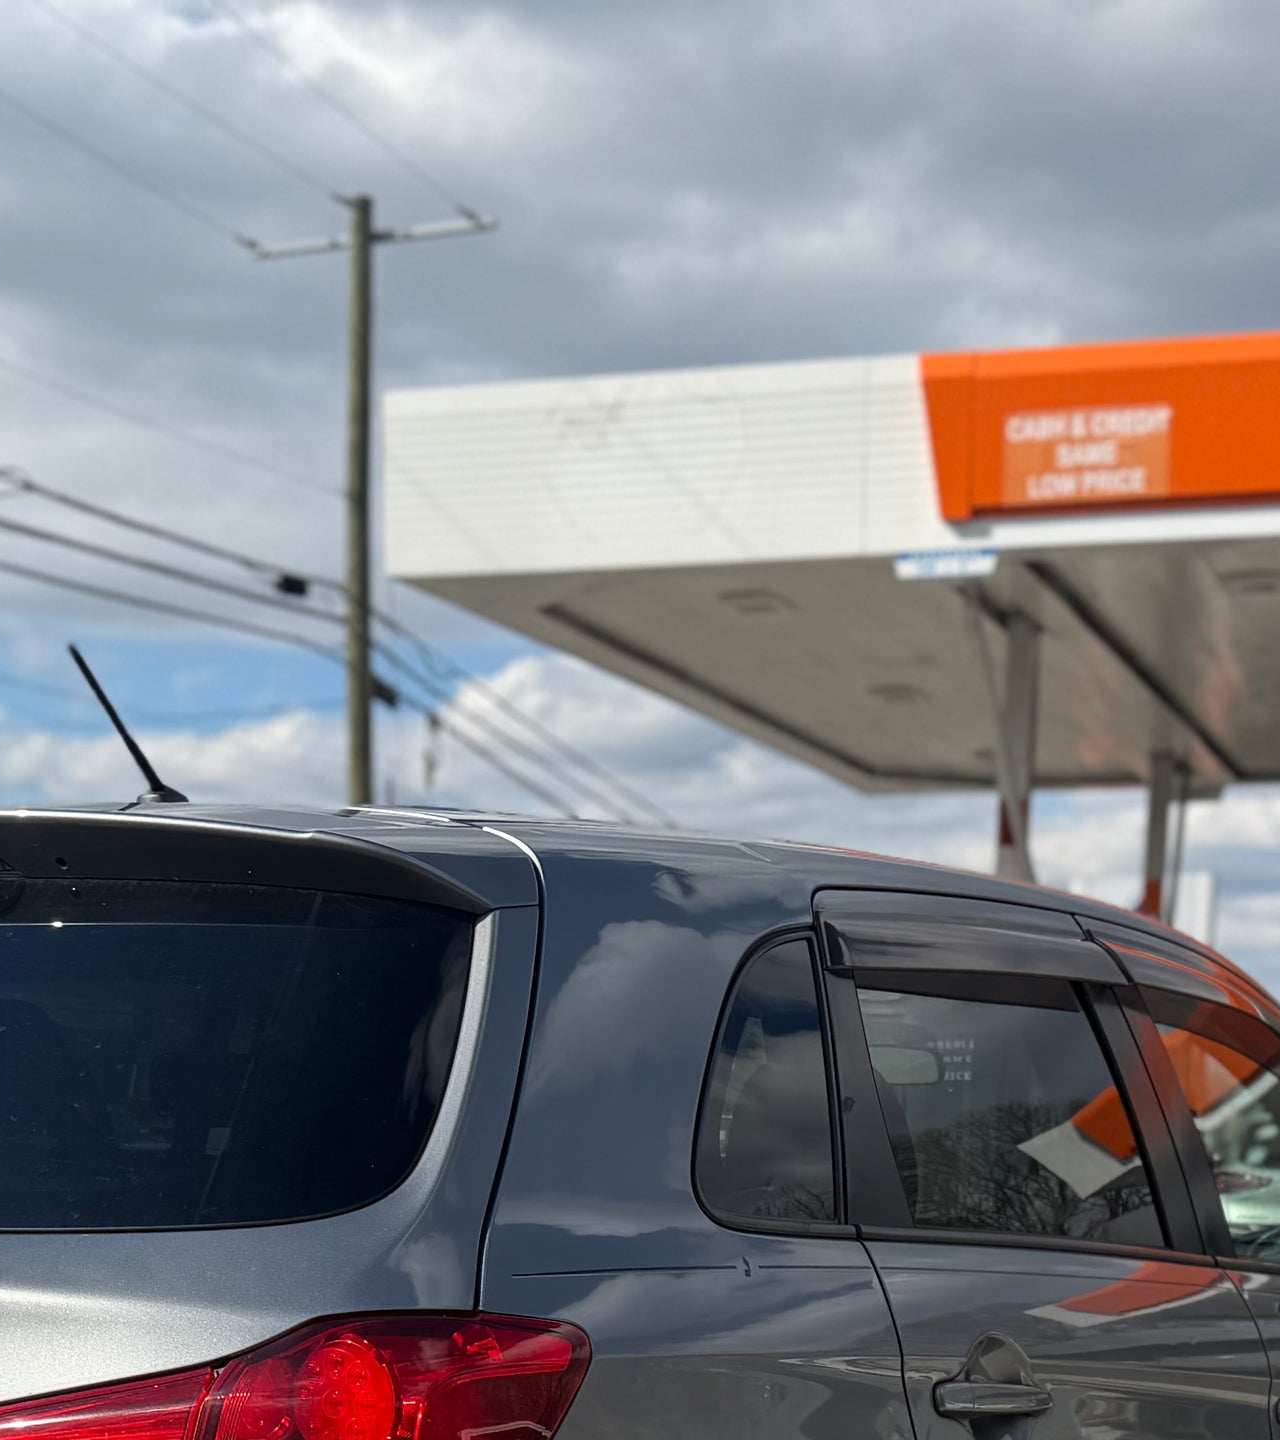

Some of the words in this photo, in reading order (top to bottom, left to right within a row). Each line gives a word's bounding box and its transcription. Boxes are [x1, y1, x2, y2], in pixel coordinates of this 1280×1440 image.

[1004, 414, 1065, 443] CASH
[1069, 411, 1087, 438] &
[1089, 405, 1172, 436] CREDIT
[1055, 441, 1118, 469] SAME
[1026, 474, 1076, 500] LOW
[1080, 468, 1147, 493] PRICE
